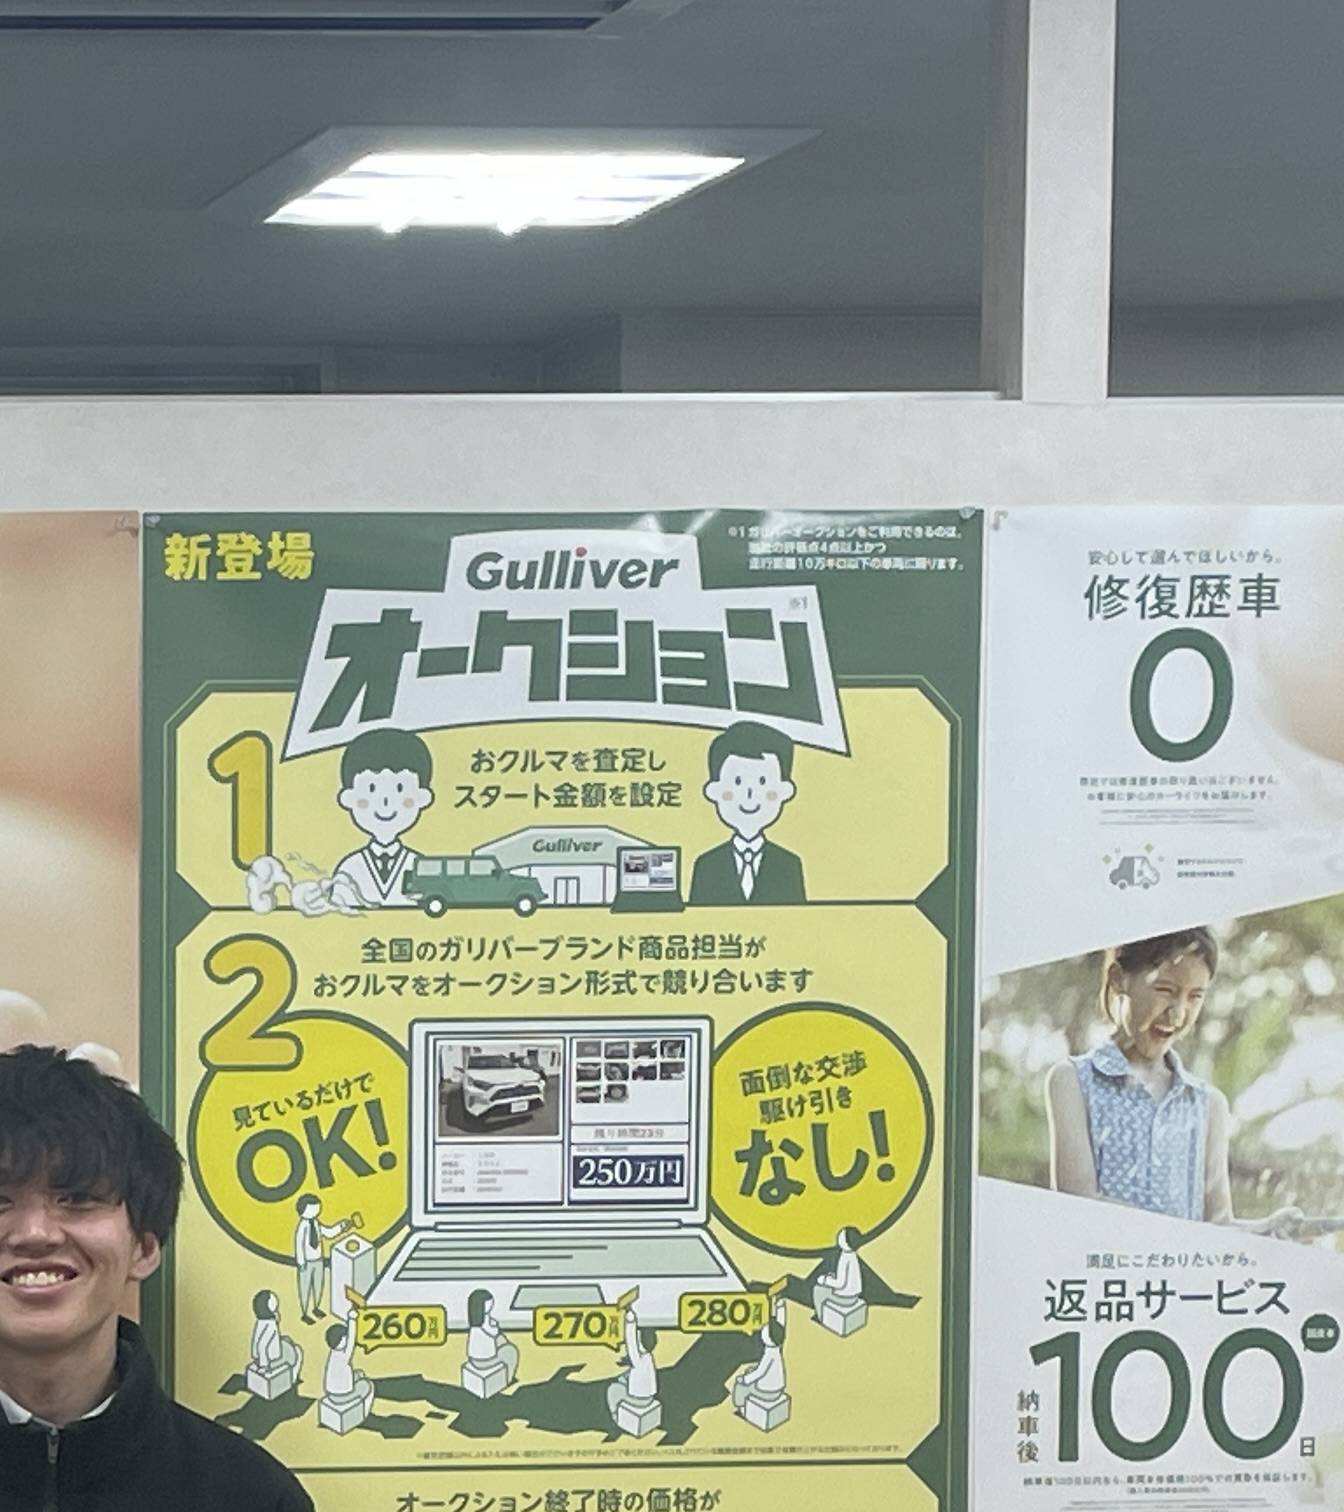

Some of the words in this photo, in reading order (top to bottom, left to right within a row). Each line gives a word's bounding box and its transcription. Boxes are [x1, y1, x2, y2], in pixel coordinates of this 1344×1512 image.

[164, 531, 315, 583] 新登場
[465, 545, 681, 591] Gulliver
[1087, 548, 1283, 566] 安心して選んでほしいから。
[1084, 572, 1281, 621] 修復歴車
[309, 604, 825, 732] オークション
[1129, 625, 1235, 764] 0
[470, 748, 668, 775] おクルマを査定し
[206, 730, 274, 870] 1
[453, 781, 683, 809] スタート金額を設定
[531, 836, 604, 855] Gulliver
[360, 934, 768, 963] 全国のガリバーブランド商品担当が
[200, 932, 304, 1070] 2
[312, 967, 814, 999] おクルマをオークション形式で競り合います
[737, 1051, 868, 1098] 面倒な交渉
[231, 1071, 376, 1132] 見ているだけで
[758, 1085, 854, 1126] 駆け引き
[235, 1098, 399, 1205] OK!
[578, 1158, 682, 1186] 250万円
[1043, 1277, 1291, 1323] 返品サービス
[1028, 1326, 1305, 1463] 100
[1016, 1389, 1041, 1465] 納車後
[1299, 1436, 1316, 1457] 日
